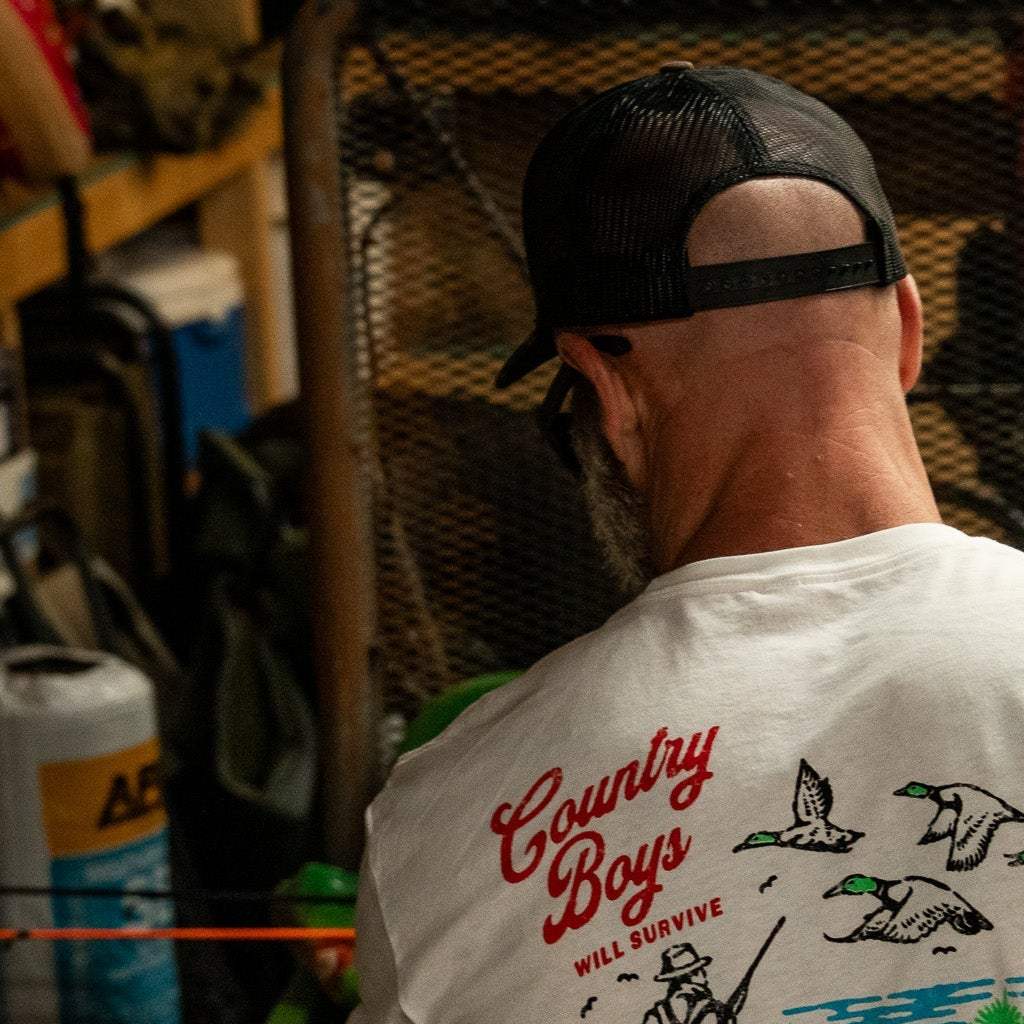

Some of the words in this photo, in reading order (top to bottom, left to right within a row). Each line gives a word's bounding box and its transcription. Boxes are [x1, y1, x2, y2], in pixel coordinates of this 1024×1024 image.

[491, 725, 720, 884] Country
[543, 826, 692, 945] Boys
[574, 941, 625, 977] WILL
[630, 897, 724, 950] SURVIVE
